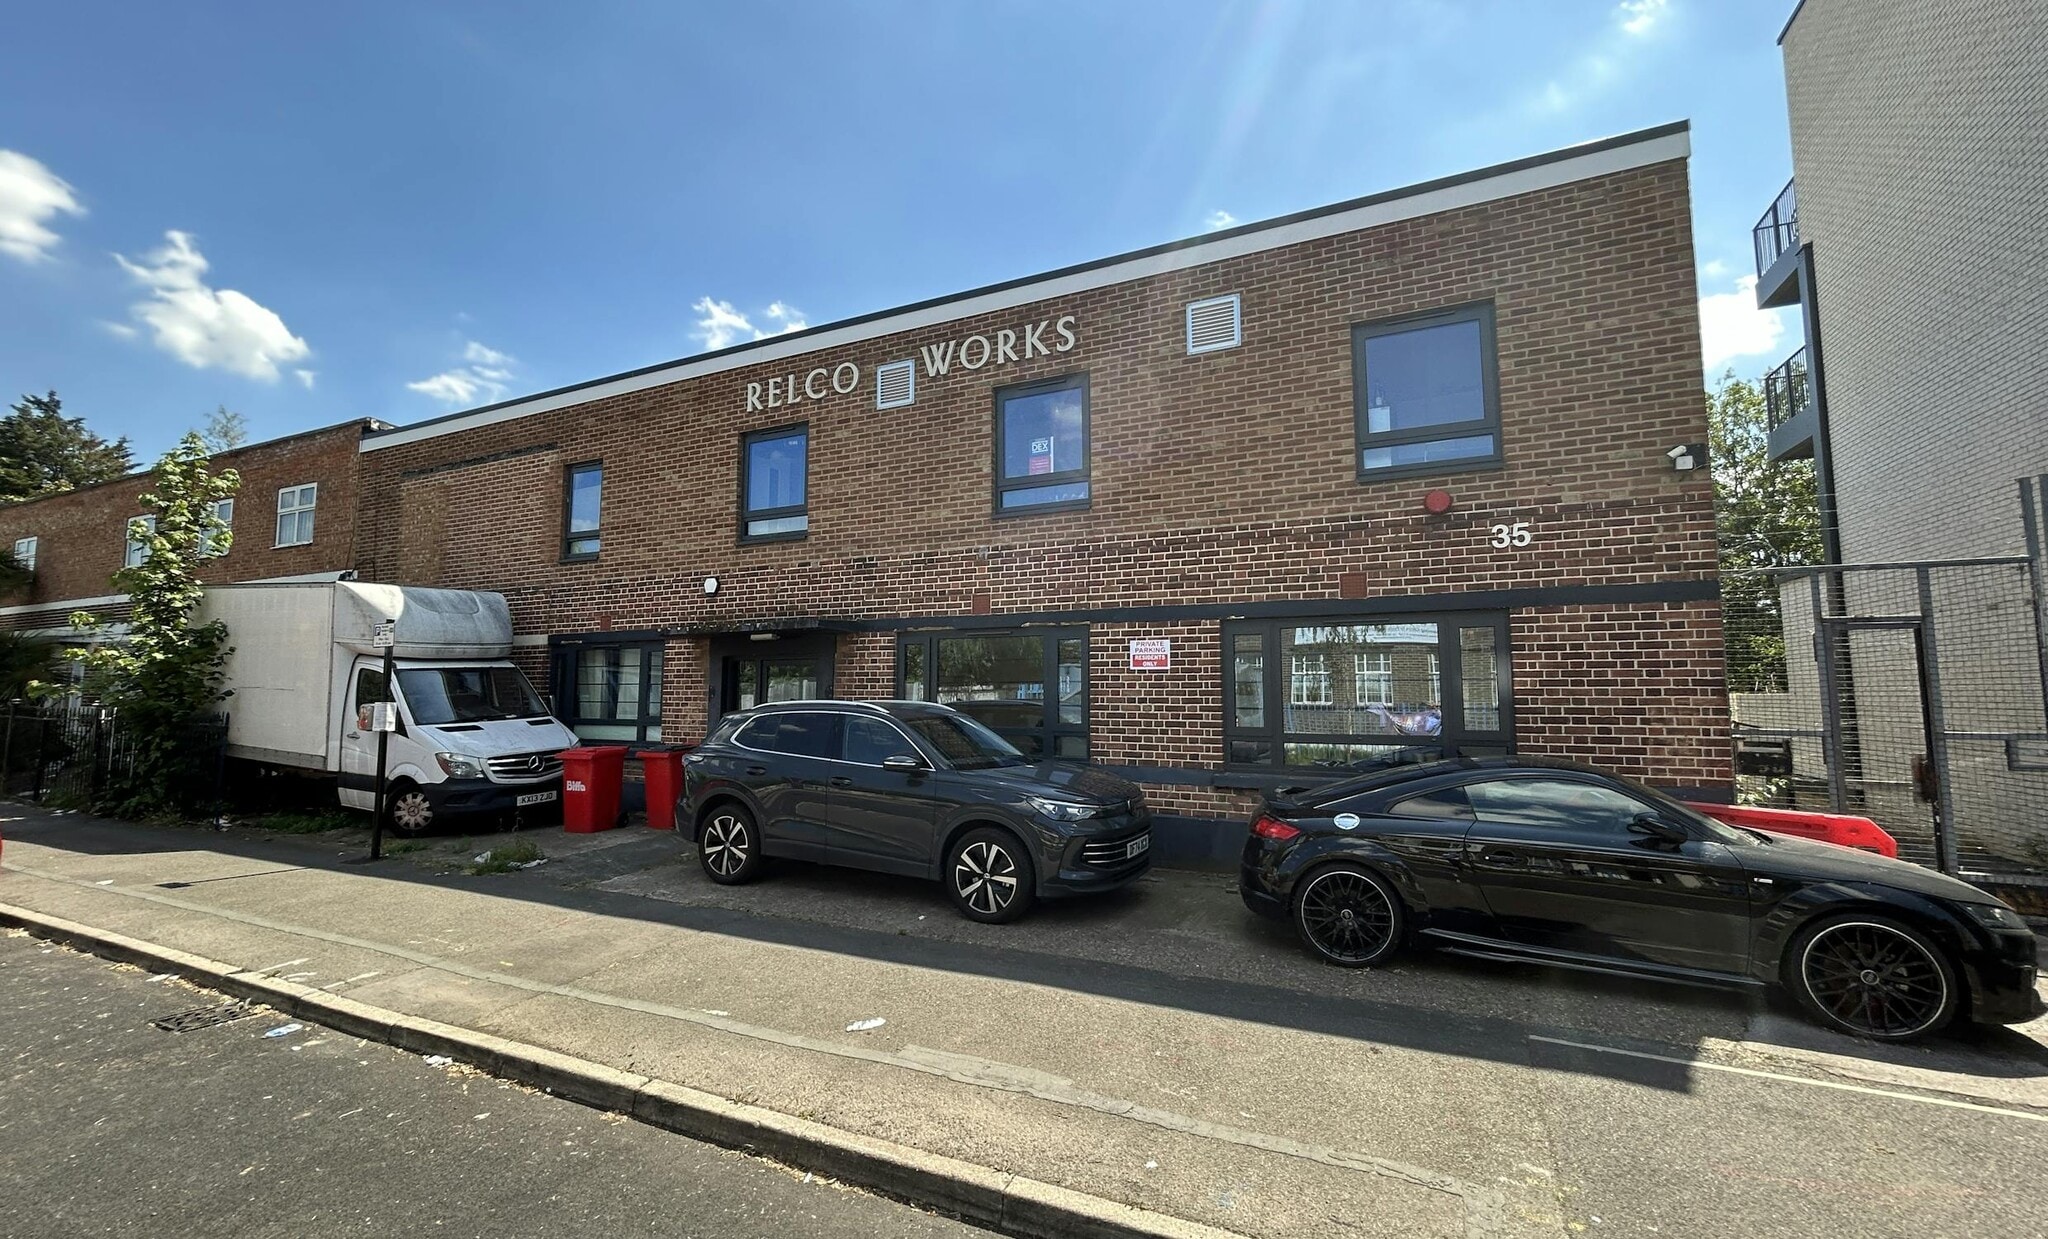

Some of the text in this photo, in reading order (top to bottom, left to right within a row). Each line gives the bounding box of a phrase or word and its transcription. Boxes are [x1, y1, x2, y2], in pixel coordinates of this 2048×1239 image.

[747, 316, 1075, 412] RELCO WORKS
[1491, 522, 1531, 549] 35
[566, 780, 586, 791] Biffa
[521, 795, 538, 804] KX13
